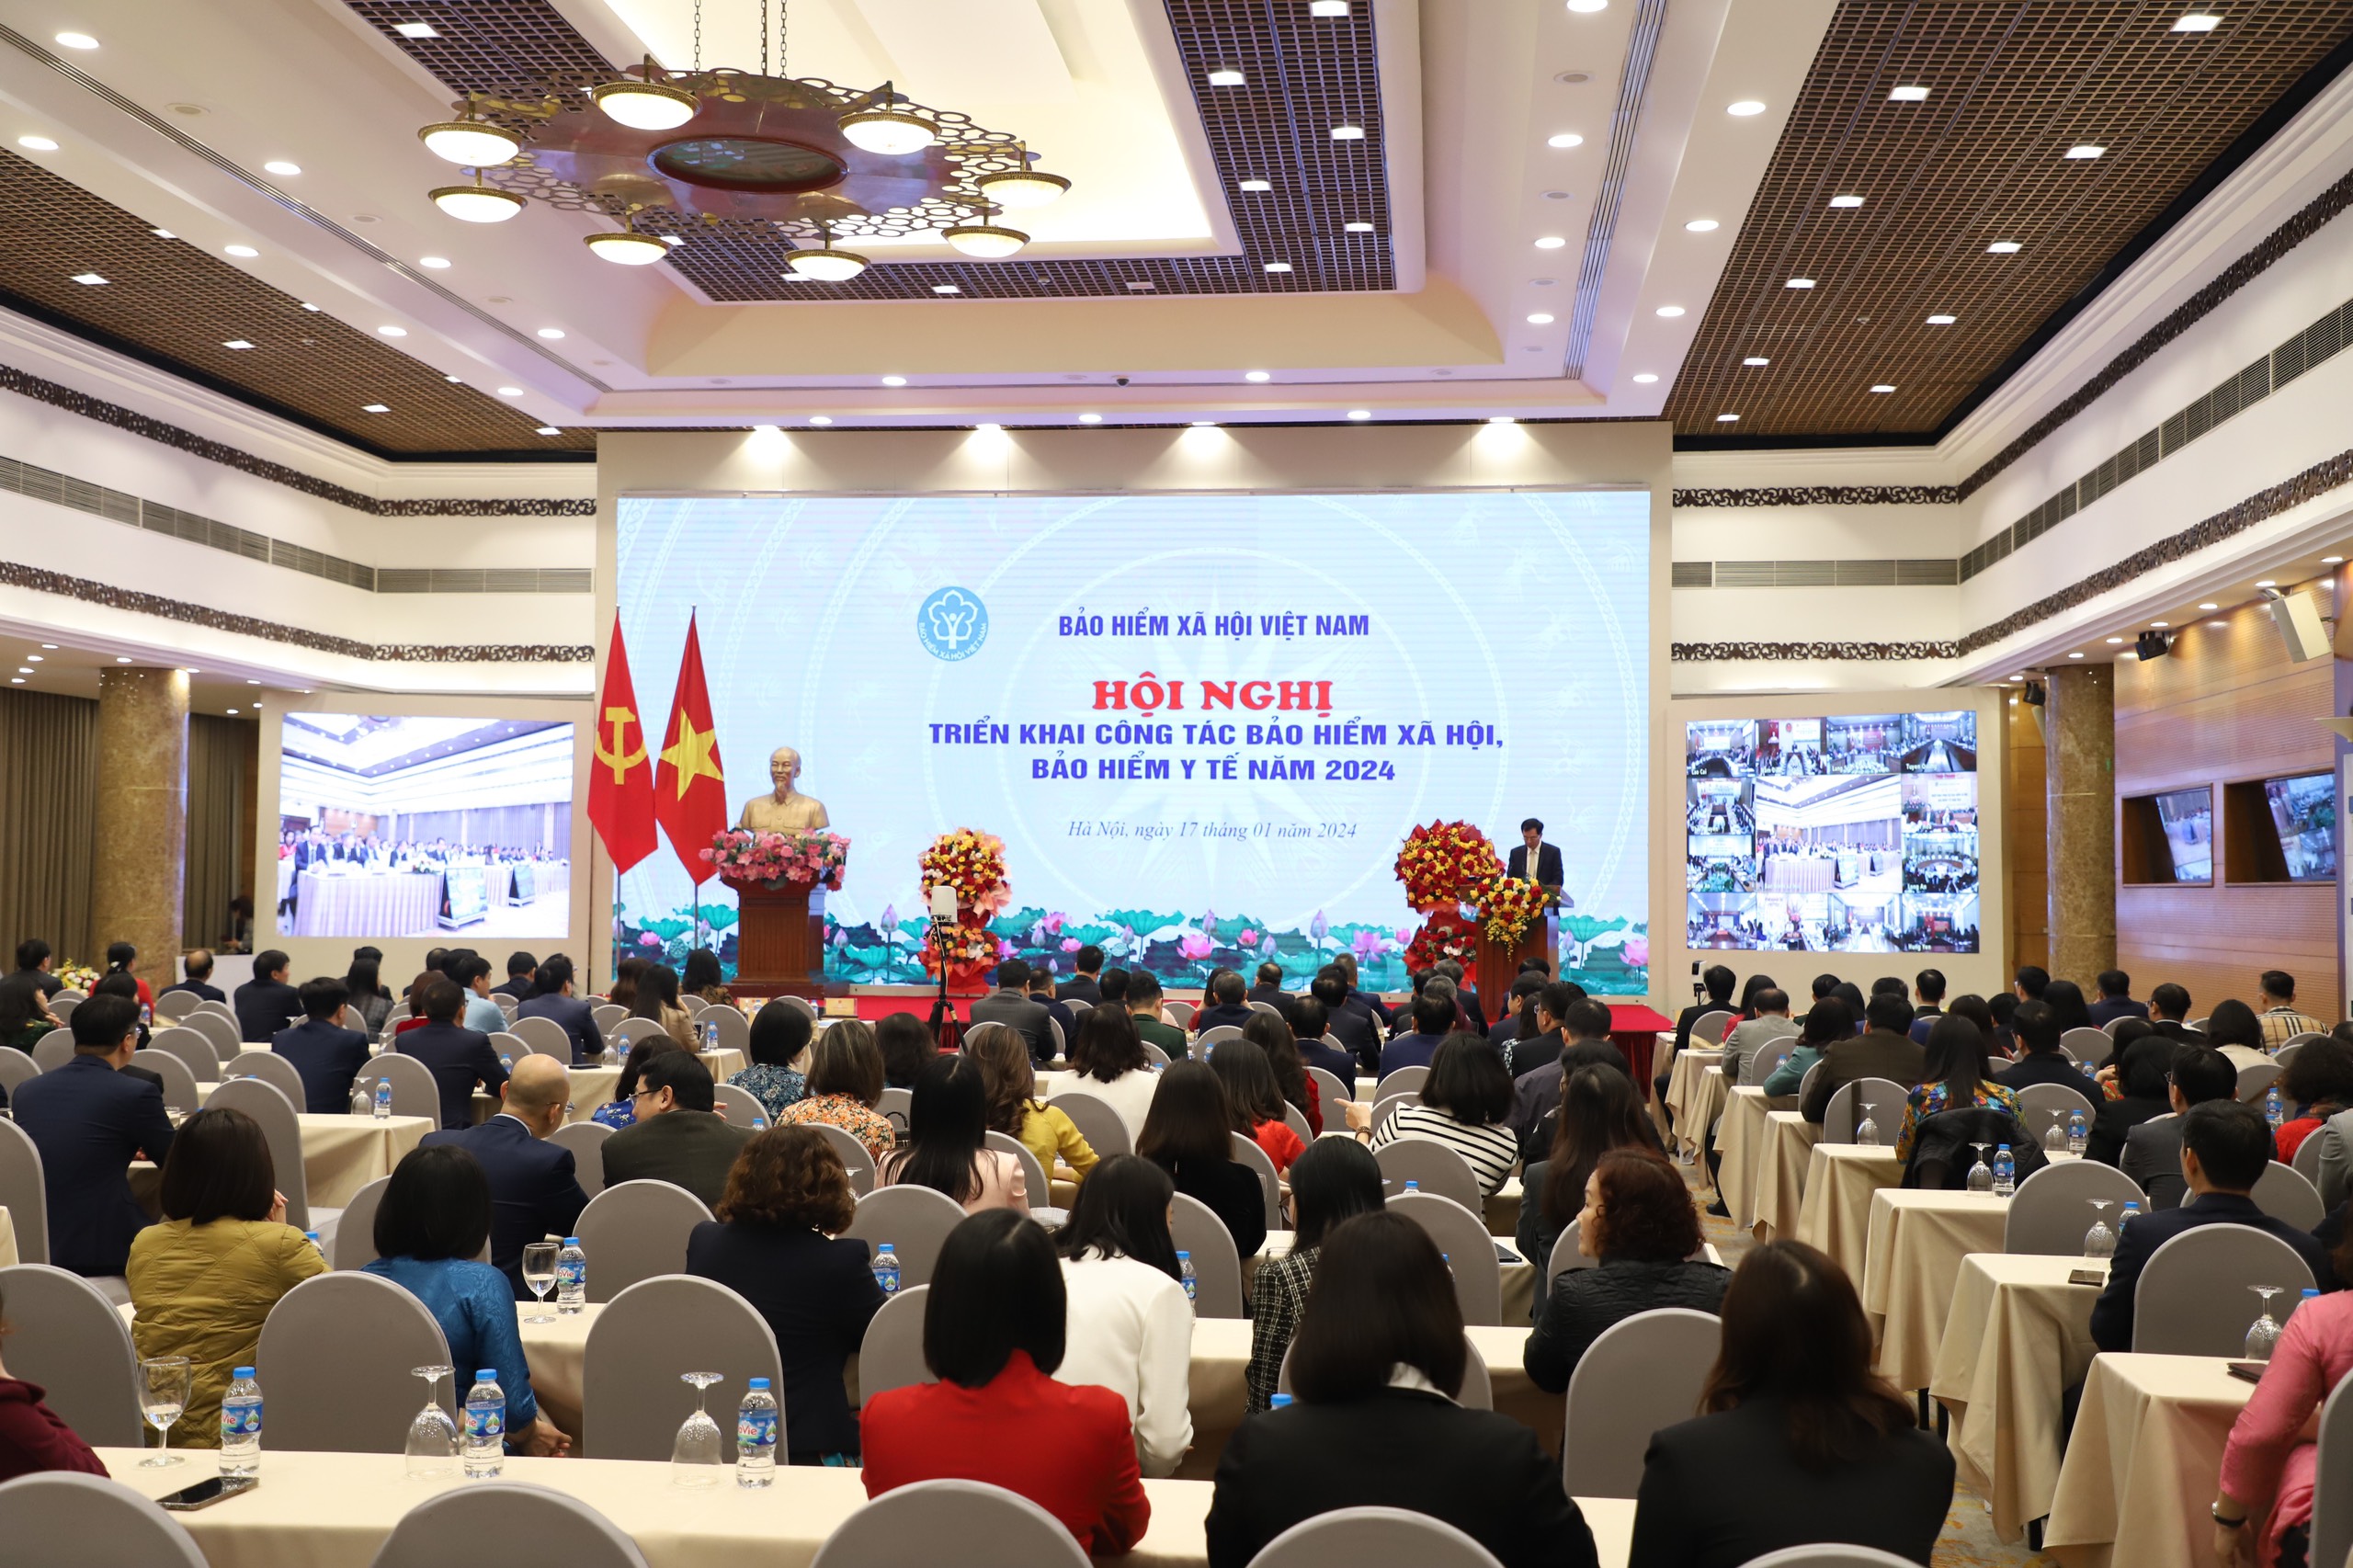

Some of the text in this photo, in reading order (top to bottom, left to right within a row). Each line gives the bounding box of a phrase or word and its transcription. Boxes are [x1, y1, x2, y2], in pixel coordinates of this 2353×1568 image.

[1059, 607, 1369, 641] BẢO HIỂM XÃ HỘI VIỆT NAM
[1092, 671, 1333, 718] HỘI NGHỊ
[929, 715, 1503, 750] TRIỂN KHAI CÔNG TÁC BẢO HIỂM XÃ HỘI,
[1032, 750, 1395, 780] BẢO HIỂM Y TẾ NĂM 2024
[1068, 821, 1357, 841] Hà Nội, ngày 17 tháng 01 năm 2024
